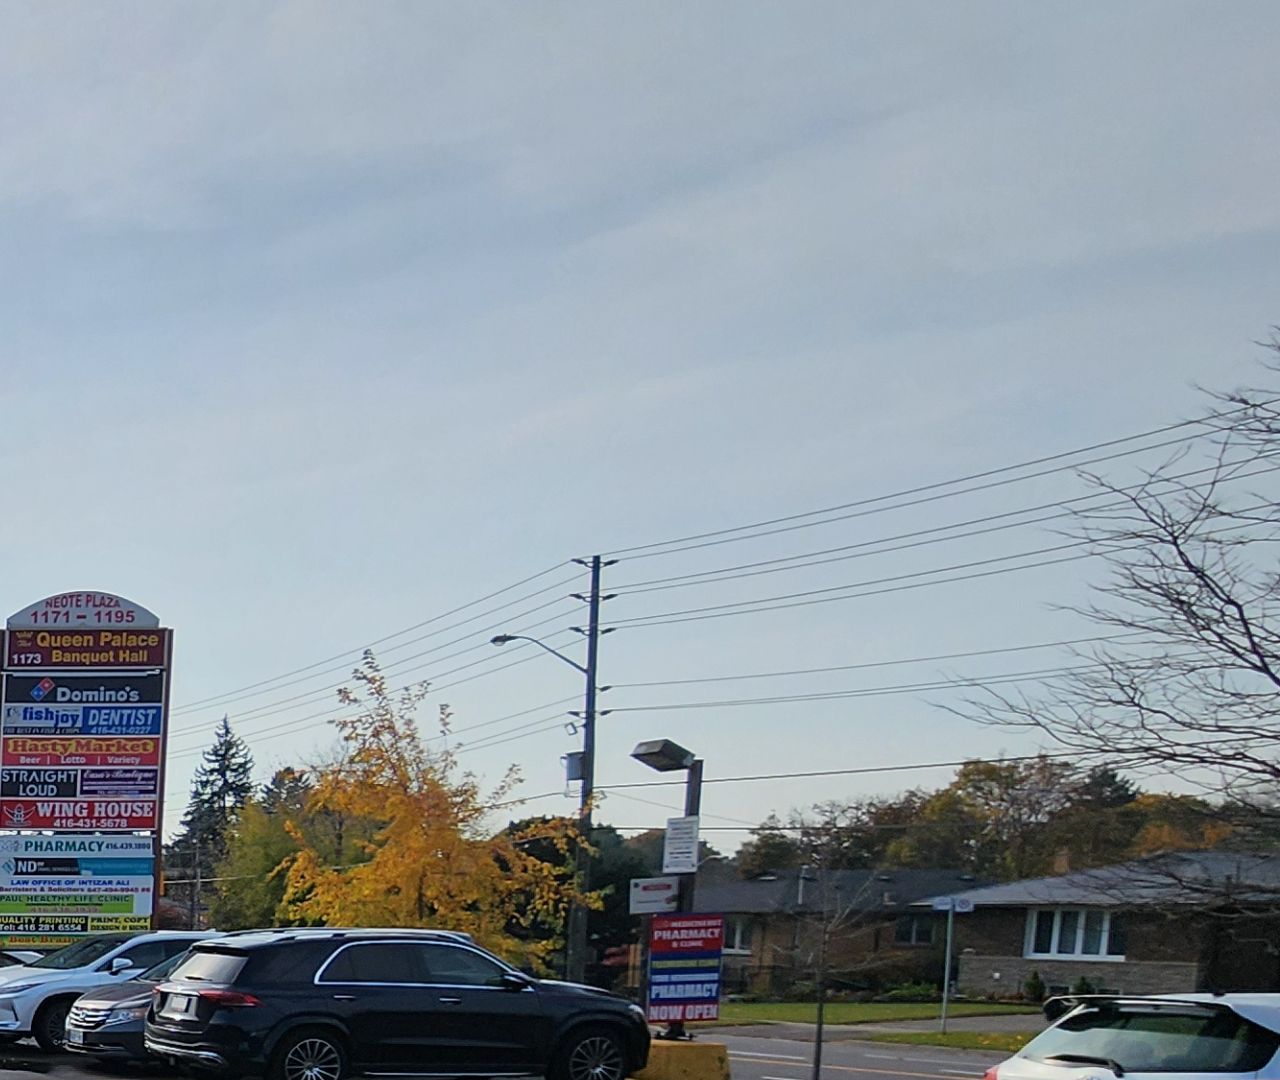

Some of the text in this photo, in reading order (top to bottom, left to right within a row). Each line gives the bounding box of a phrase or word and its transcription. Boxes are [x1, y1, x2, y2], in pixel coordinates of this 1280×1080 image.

[45, 594, 120, 608] NEOTE PLAZA
[30, 611, 70, 623] 1171
[94, 610, 135, 623] 1195
[36, 632, 94, 648] Queen
[99, 631, 159, 647] Palace
[12, 653, 41, 664] 1173
[52, 650, 148, 665] Banquet Hall
[56, 686, 140, 702] Domino's
[22, 706, 80, 728] fishjoy
[88, 708, 157, 726] DENTIST
[10, 738, 152, 756] Hasty Market
[20, 756, 140, 764] Beer Lotto Variety
[2, 770, 76, 782] STRAIGHT
[18, 784, 58, 796] LOUD
[36, 802, 153, 818] WING HOUSE
[54, 818, 128, 828] 416-431-5678
[24, 840, 105, 852] PHARMACY
[16, 861, 37, 873] ND
[40, 916, 86, 924] PRINTING
[8, 936, 36, 944] Best
[654, 928, 721, 940] PHARMACY
[651, 983, 718, 999] PHARMACY
[649, 1004, 718, 1020] NOW OPEN
